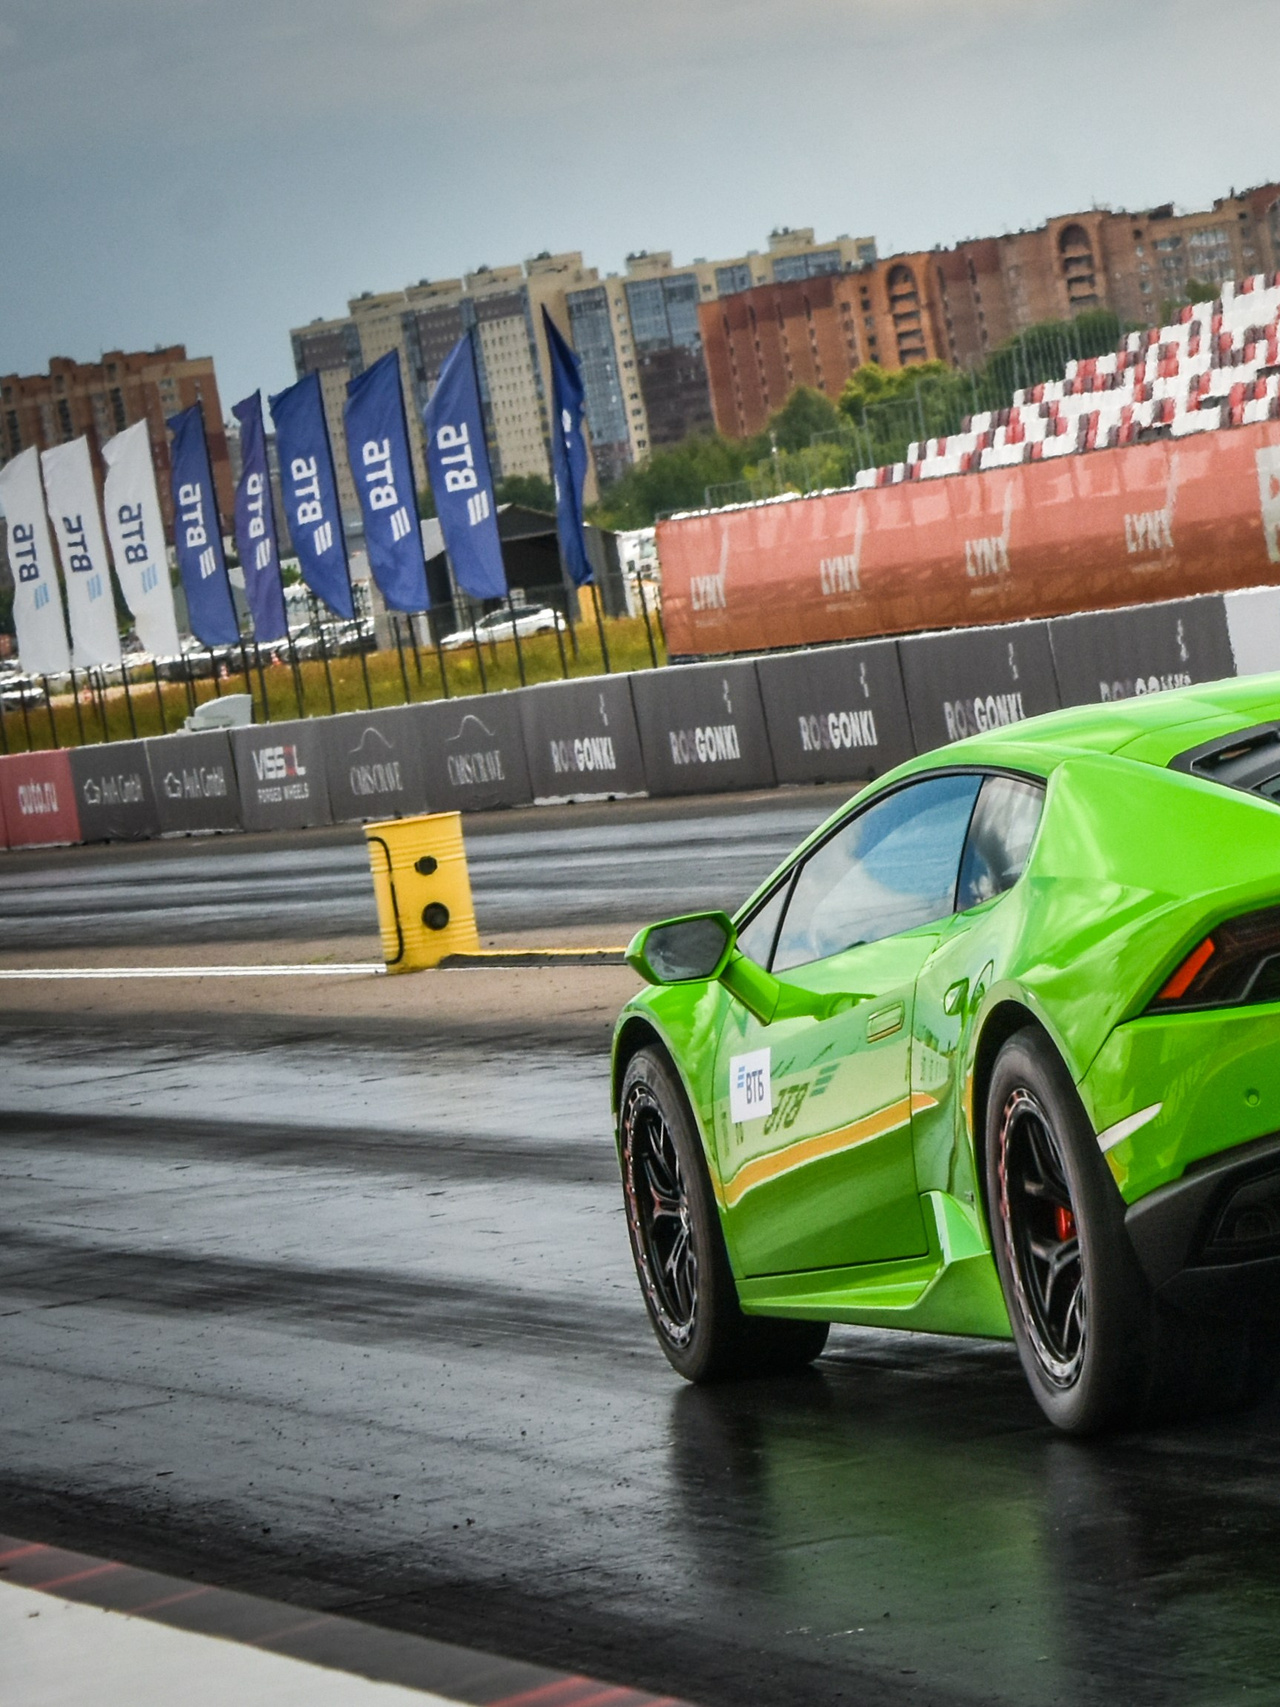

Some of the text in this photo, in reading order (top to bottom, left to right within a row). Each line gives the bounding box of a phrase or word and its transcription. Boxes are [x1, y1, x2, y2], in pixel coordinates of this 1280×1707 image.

[669, 724, 741, 765] ROSGONKI
[798, 710, 878, 751] ROSGONKI
[745, 1069, 765, 1104] ВТБ
